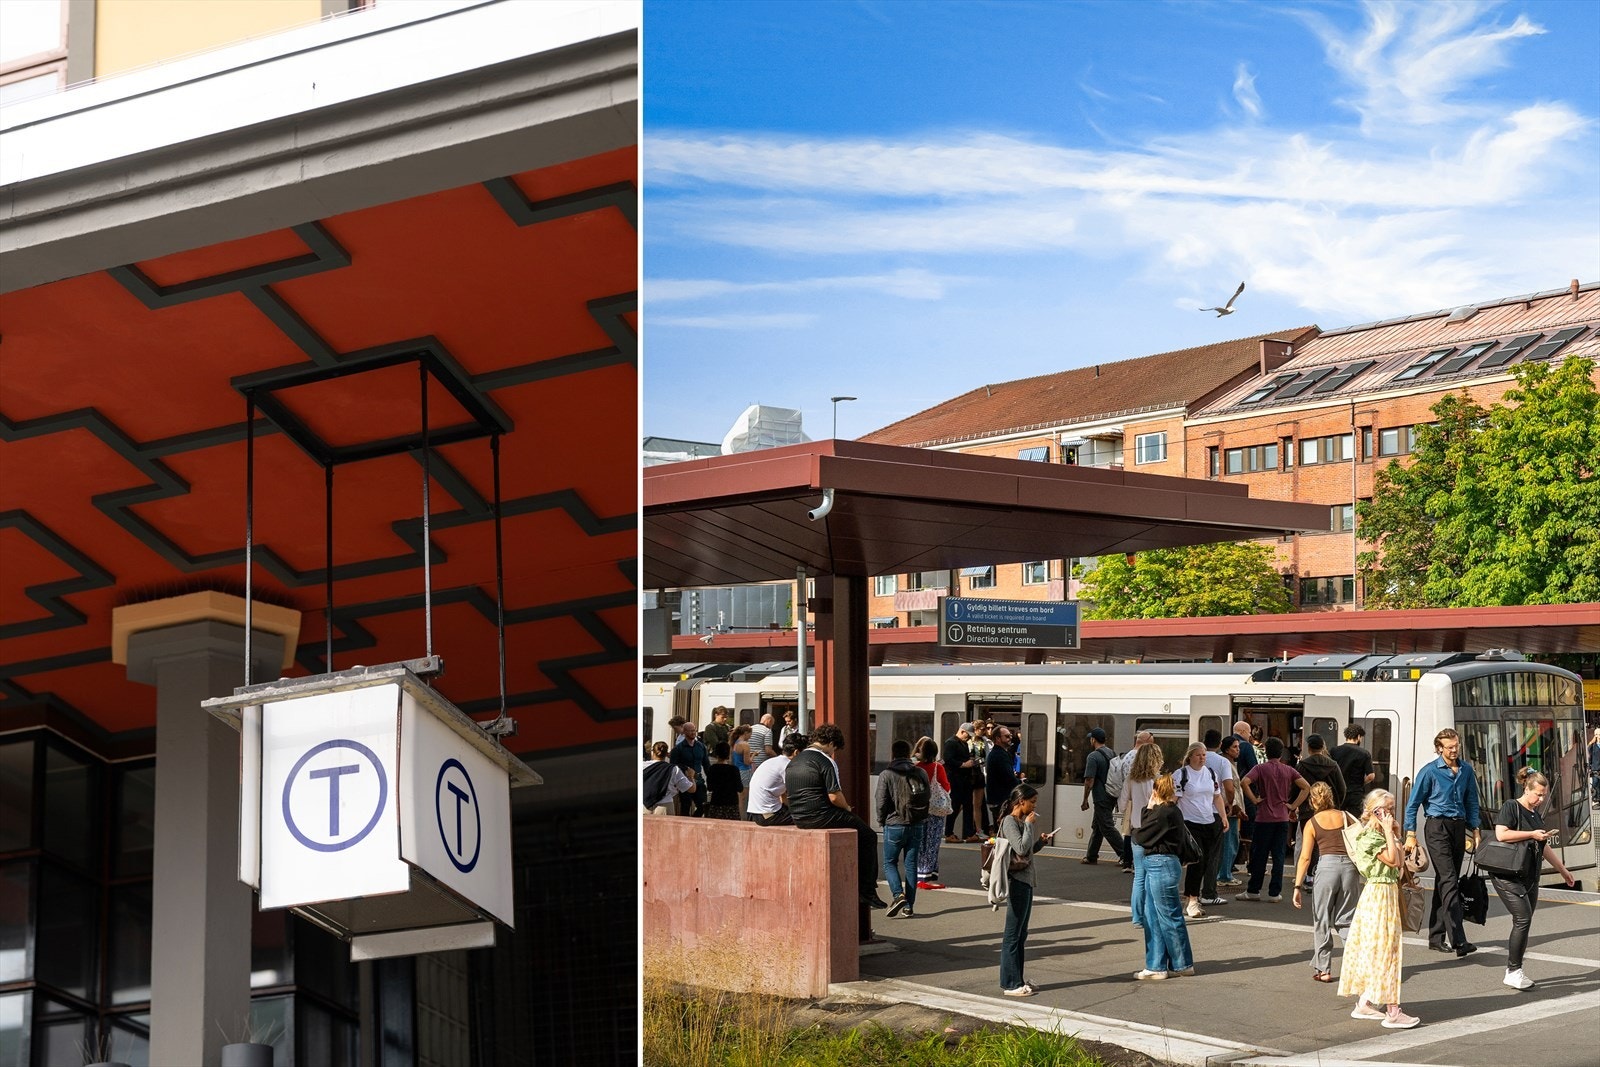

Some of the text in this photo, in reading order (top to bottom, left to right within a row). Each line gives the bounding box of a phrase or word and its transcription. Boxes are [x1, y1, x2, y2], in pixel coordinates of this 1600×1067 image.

[967, 603, 987, 612] Gyldig
[967, 624, 995, 634] Retning
[967, 635, 998, 643] Direction
[1000, 636, 1013, 645] city
[309, 764, 360, 837] T
[447, 780, 469, 857] T
